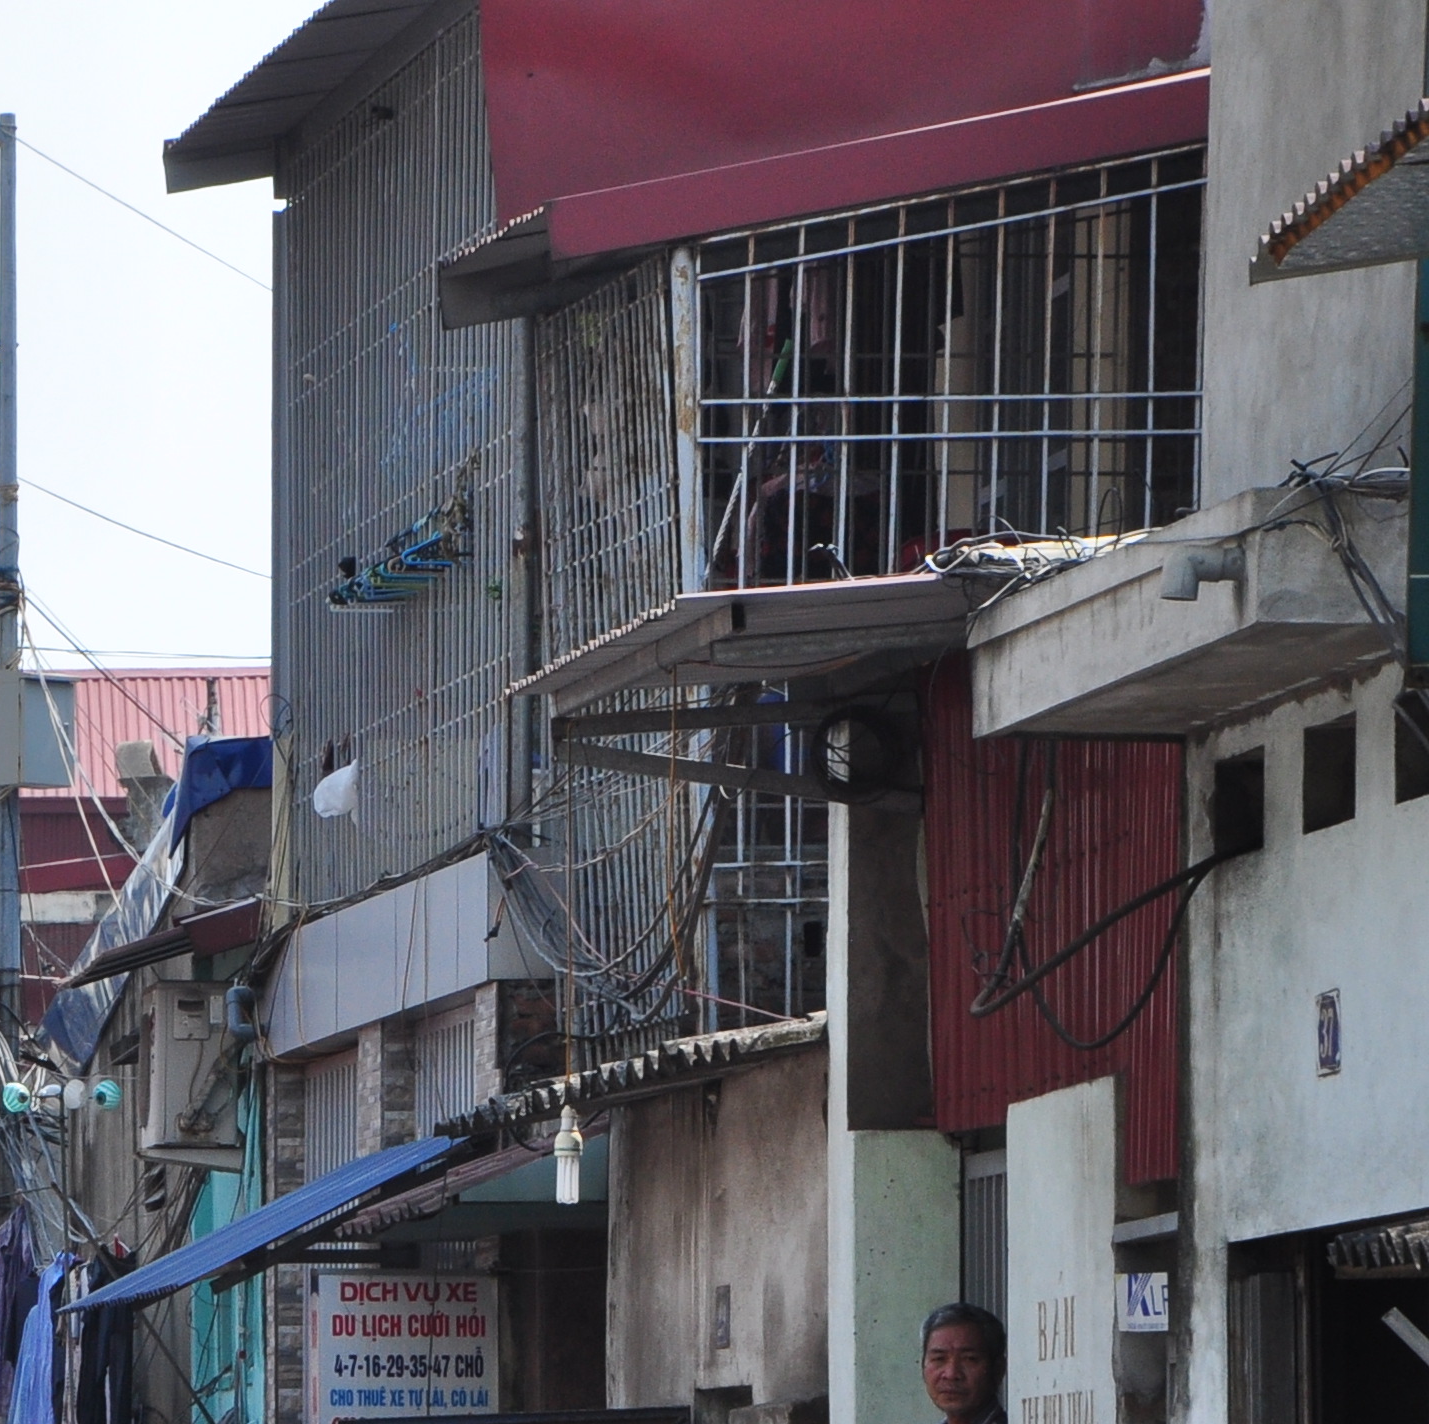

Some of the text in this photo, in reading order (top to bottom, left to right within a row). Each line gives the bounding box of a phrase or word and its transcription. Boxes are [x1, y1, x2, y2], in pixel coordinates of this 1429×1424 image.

[1320, 1007, 1334, 1058] 37
[340, 1281, 478, 1306] DỊCH VỤ XE
[332, 1313, 356, 1337] DU
[362, 1313, 403, 1342] LỊCH
[408, 1309, 450, 1338] CƯỚI
[456, 1306, 486, 1338] HỎI
[334, 1346, 485, 1378] 4-7-16-29-35-47 CHỖ
[330, 1388, 354, 1407] CHO
[357, 1385, 386, 1407] THUÊ
[390, 1388, 405, 1407] XE
[408, 1388, 424, 1411] TỰ
[451, 1386, 467, 1407] CÓ
[470, 1385, 489, 1407] LÁI
